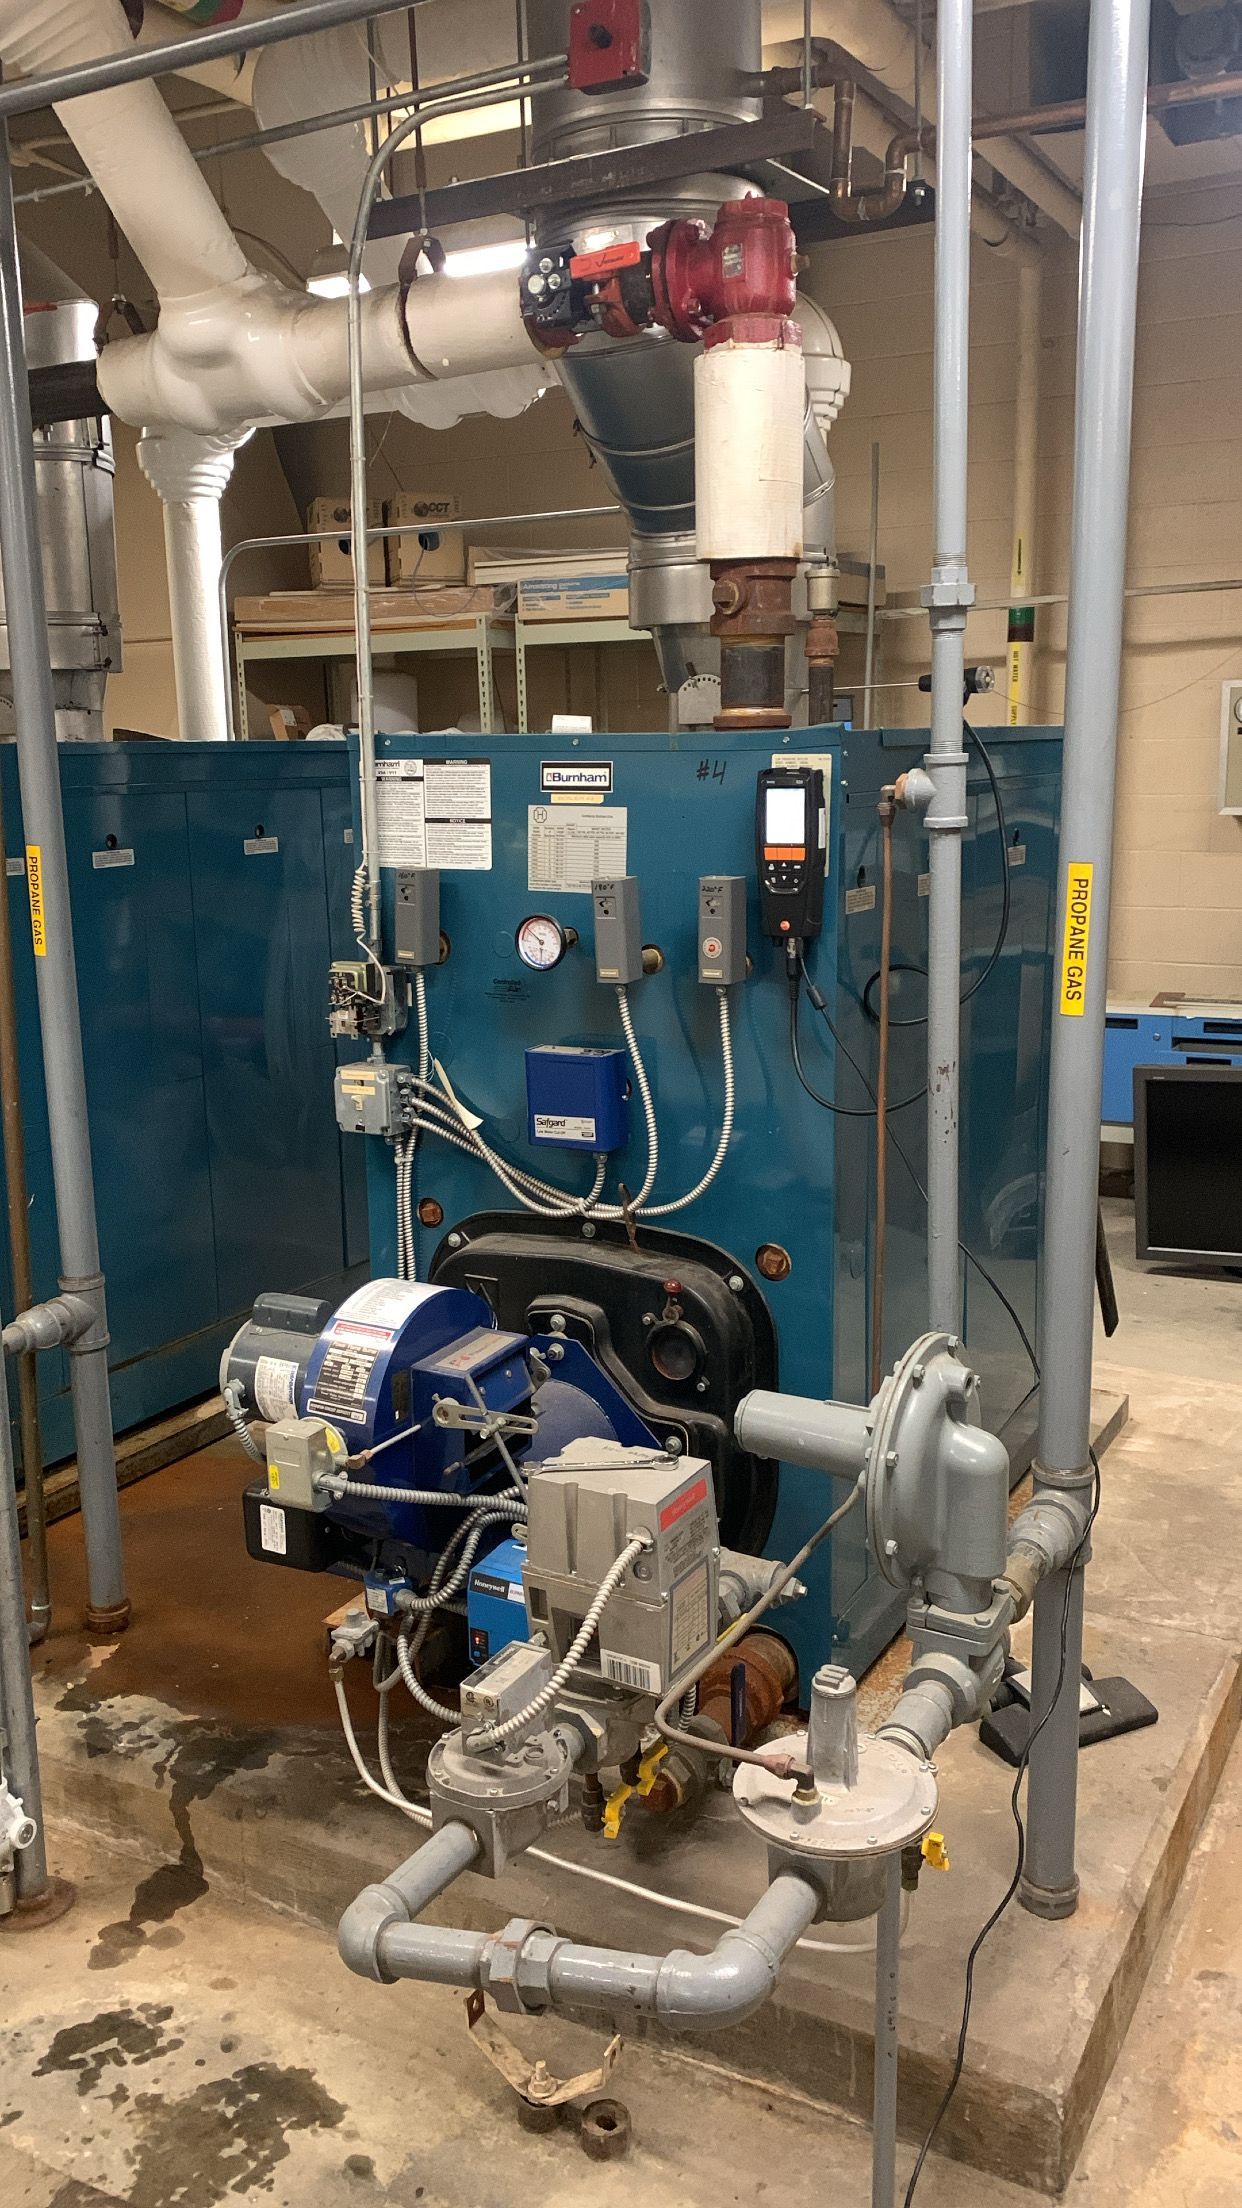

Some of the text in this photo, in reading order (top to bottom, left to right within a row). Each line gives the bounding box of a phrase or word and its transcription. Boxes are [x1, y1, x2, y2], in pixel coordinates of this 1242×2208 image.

[552, 772, 607, 783] Burnham
[696, 759, 727, 785] #4
[28, 856, 43, 945] PROPANE GAS
[1066, 878, 1089, 1000] PROPANE GAS
[536, 1117, 566, 1128] Safgard
[474, 1579, 506, 1593] Honeywell
